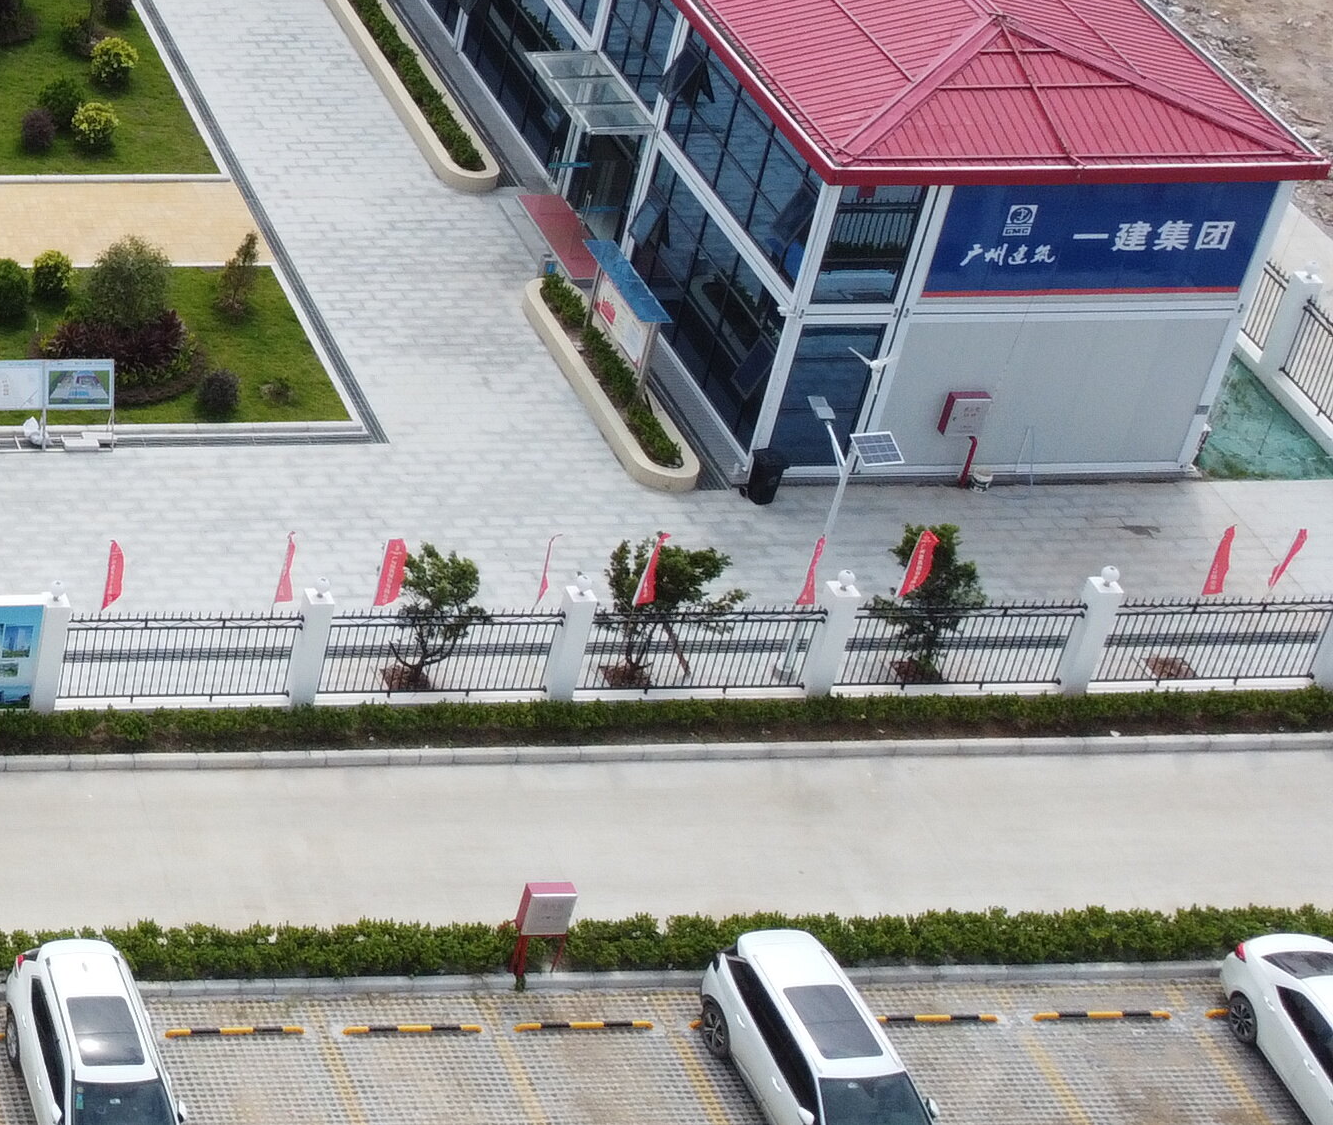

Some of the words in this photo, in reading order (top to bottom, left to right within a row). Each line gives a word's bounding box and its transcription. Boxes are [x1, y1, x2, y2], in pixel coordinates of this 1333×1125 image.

[959, 243, 1056, 266] 广州建筑
[1073, 220, 1235, 252] 一建集团
